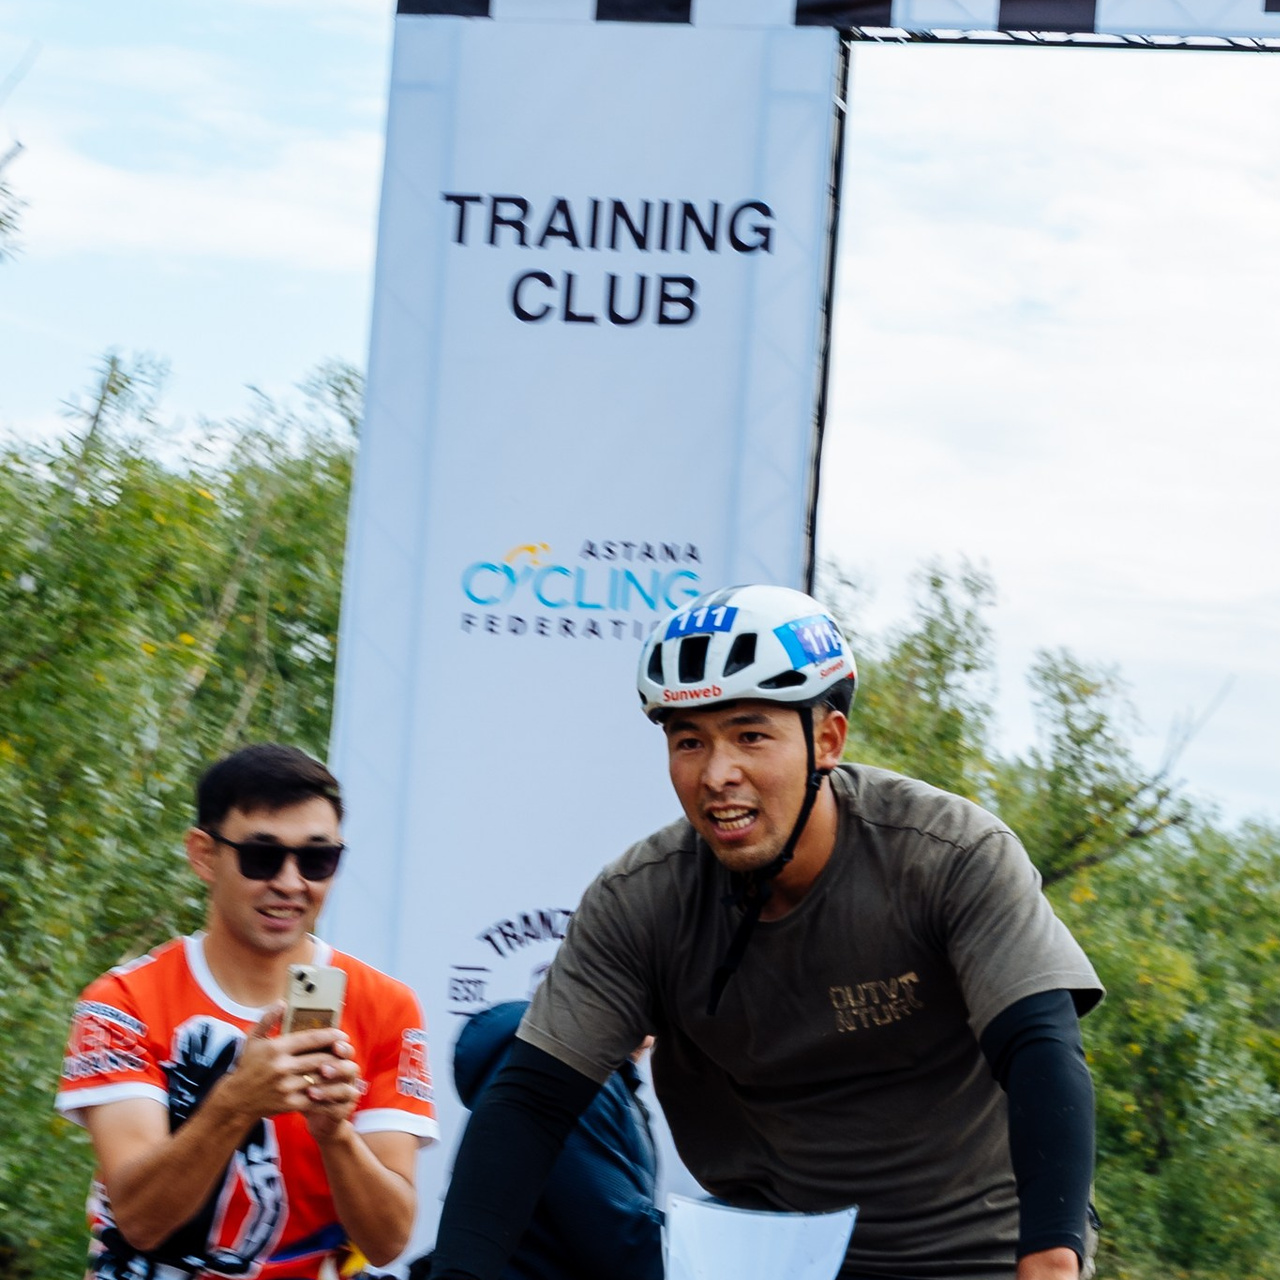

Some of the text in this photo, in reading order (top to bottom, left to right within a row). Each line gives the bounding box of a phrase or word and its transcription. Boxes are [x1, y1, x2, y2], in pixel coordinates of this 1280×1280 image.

[442, 192, 777, 254] TRAINING
[510, 270, 698, 326] CLUB
[580, 539, 702, 564] ASTANA
[461, 561, 701, 611] CYCLING
[677, 606, 727, 631] 111
[663, 685, 722, 702] Sunweb
